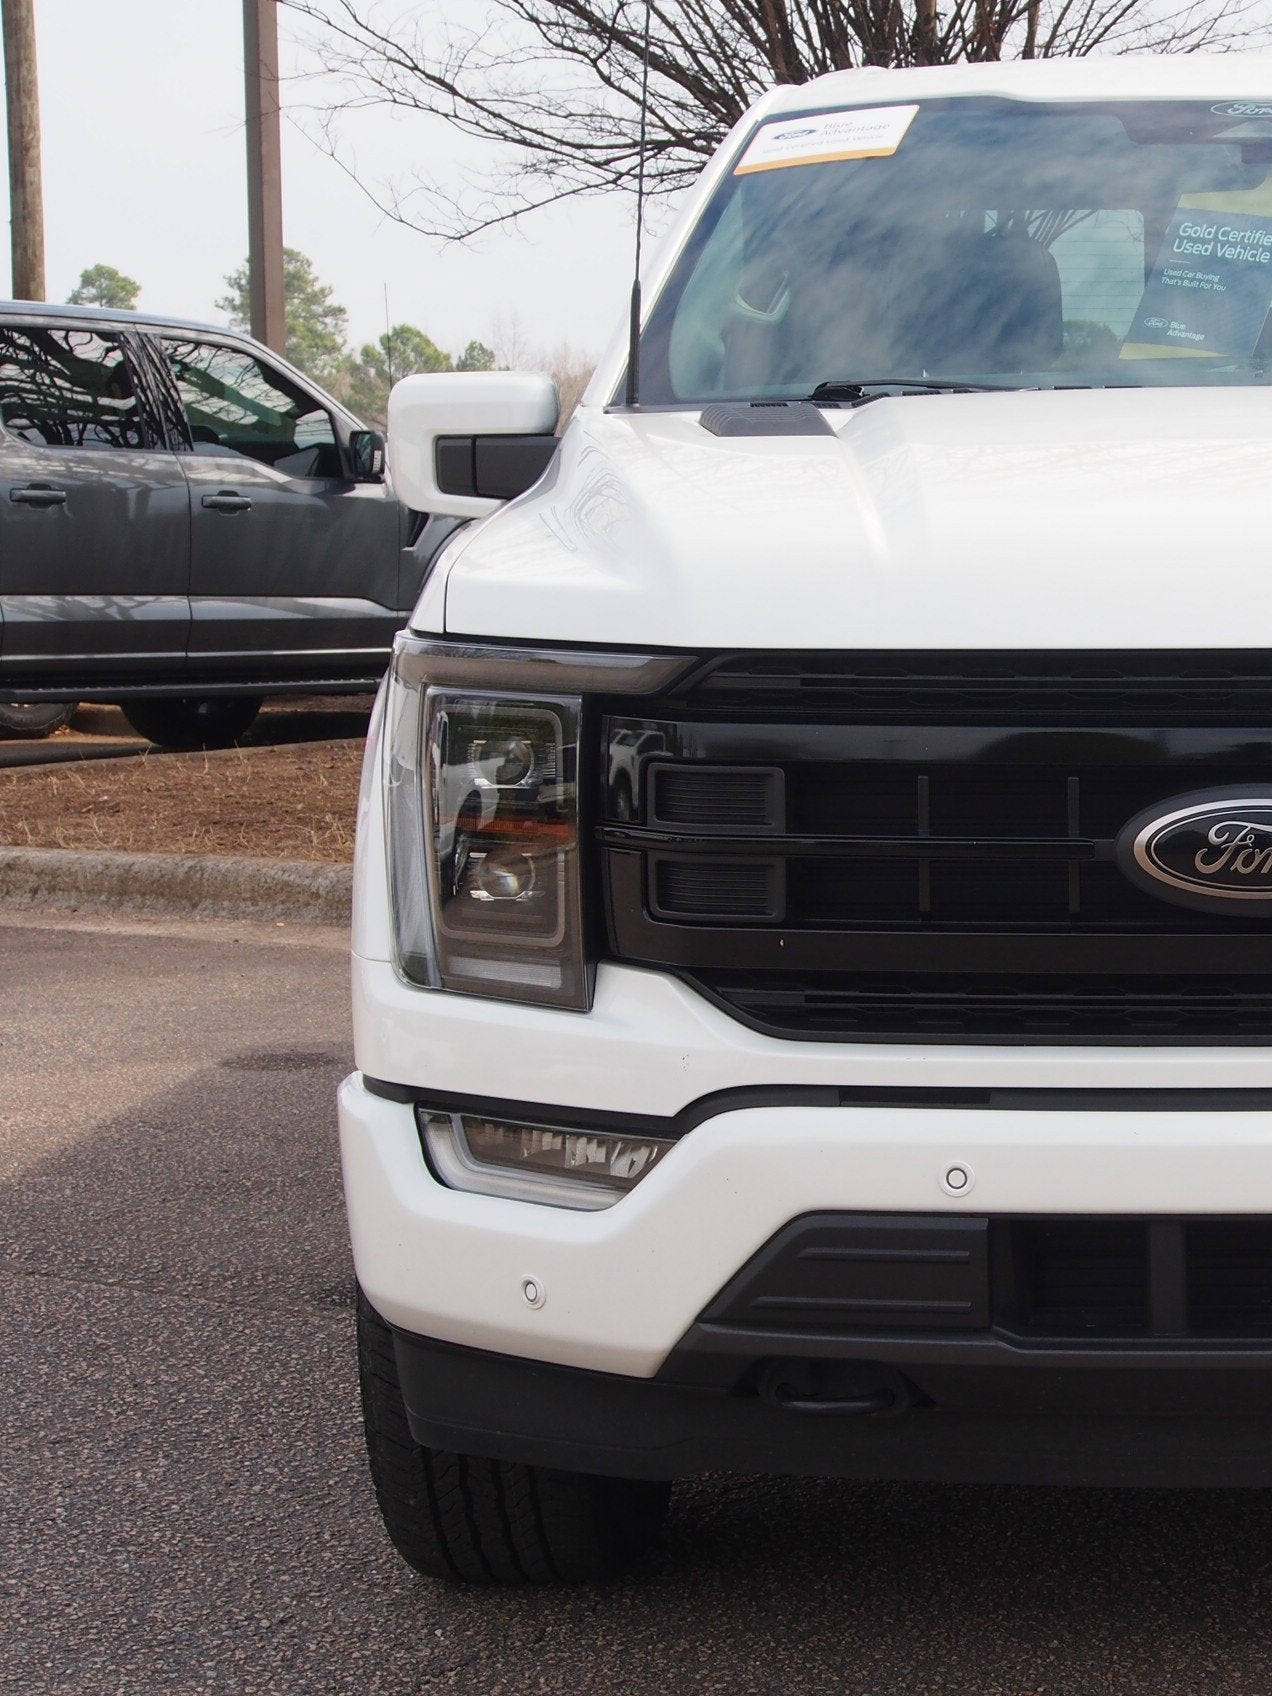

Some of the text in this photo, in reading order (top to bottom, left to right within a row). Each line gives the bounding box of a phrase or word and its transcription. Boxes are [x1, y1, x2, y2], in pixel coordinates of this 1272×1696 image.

[820, 124, 891, 136] Advantage
[1179, 222, 1216, 239] Gold
[1173, 239, 1271, 263] Used Vehicle
[1164, 268, 1220, 282] Used Car Buying
[1161, 276, 1227, 292] That's Built For You
[1170, 321, 1186, 330] Blue
[1167, 329, 1205, 341] Advantage
